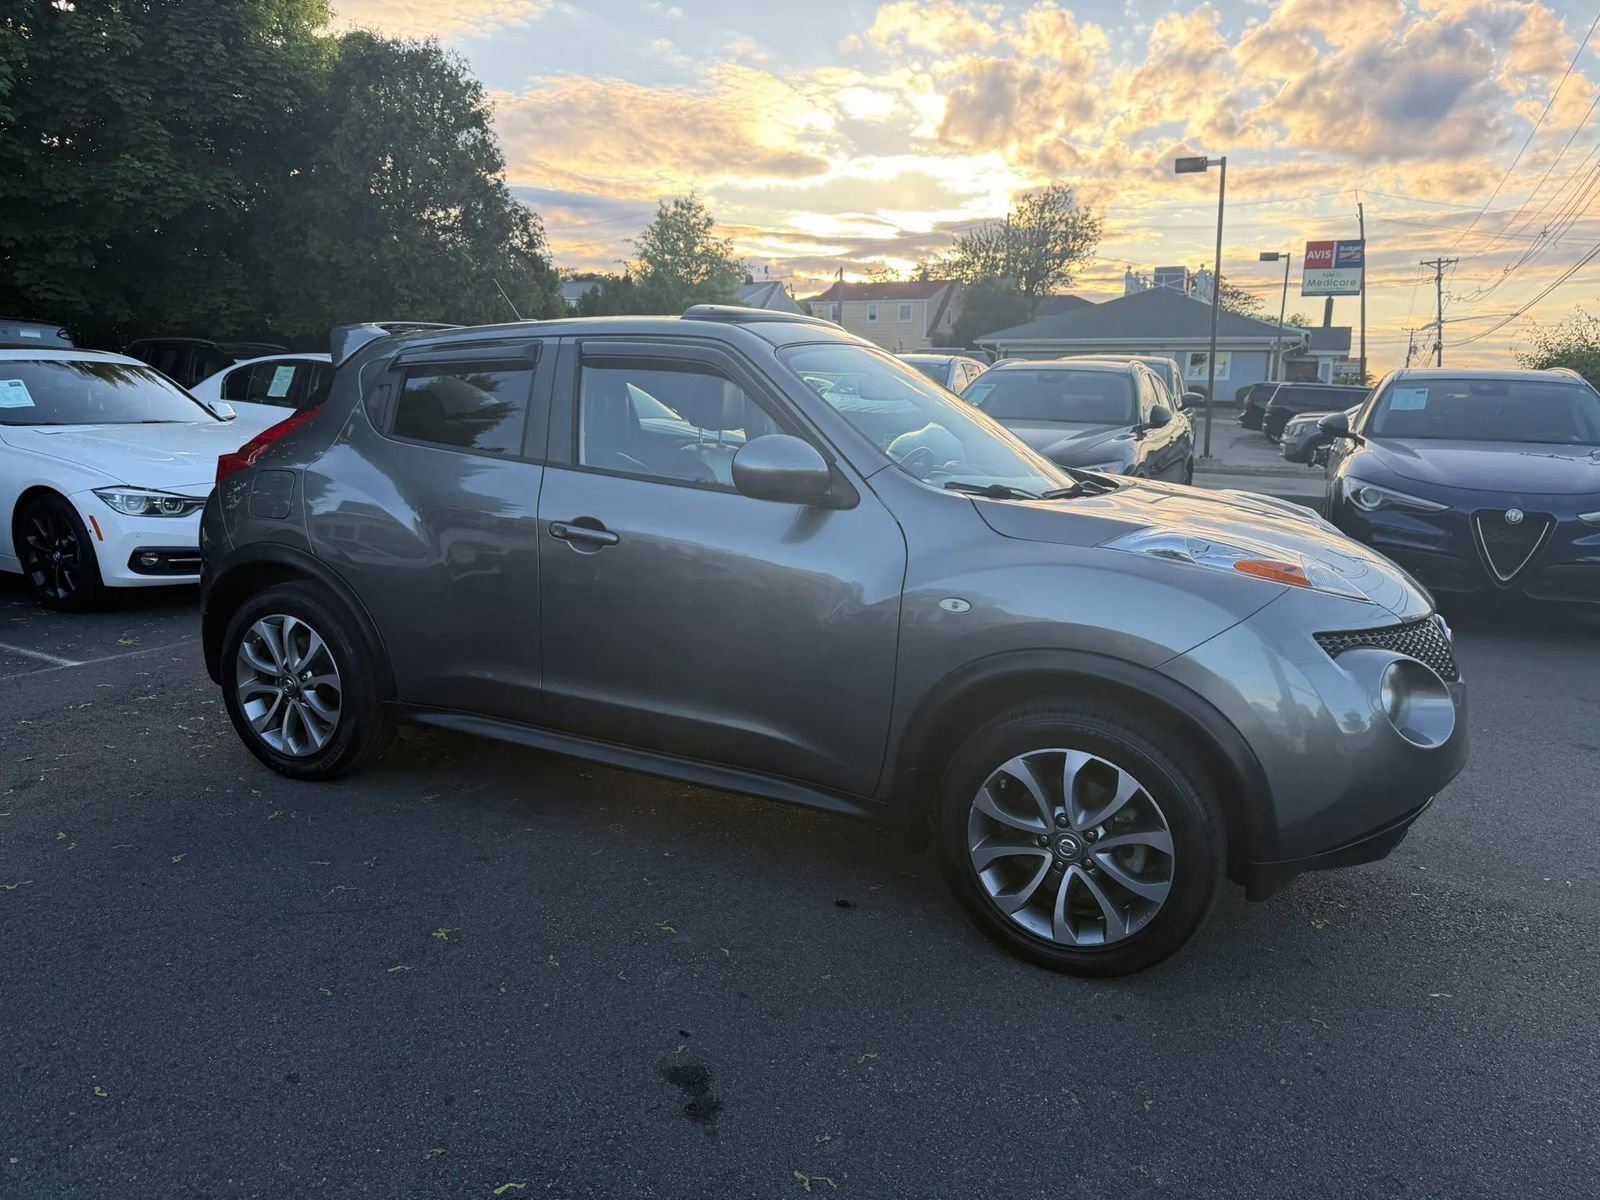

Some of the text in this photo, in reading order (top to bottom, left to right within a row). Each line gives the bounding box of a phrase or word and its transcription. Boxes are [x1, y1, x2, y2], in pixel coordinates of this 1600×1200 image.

[1339, 244, 1362, 252] Budget
[1307, 250, 1332, 260] AVIS
[1307, 278, 1357, 287] Medicare
